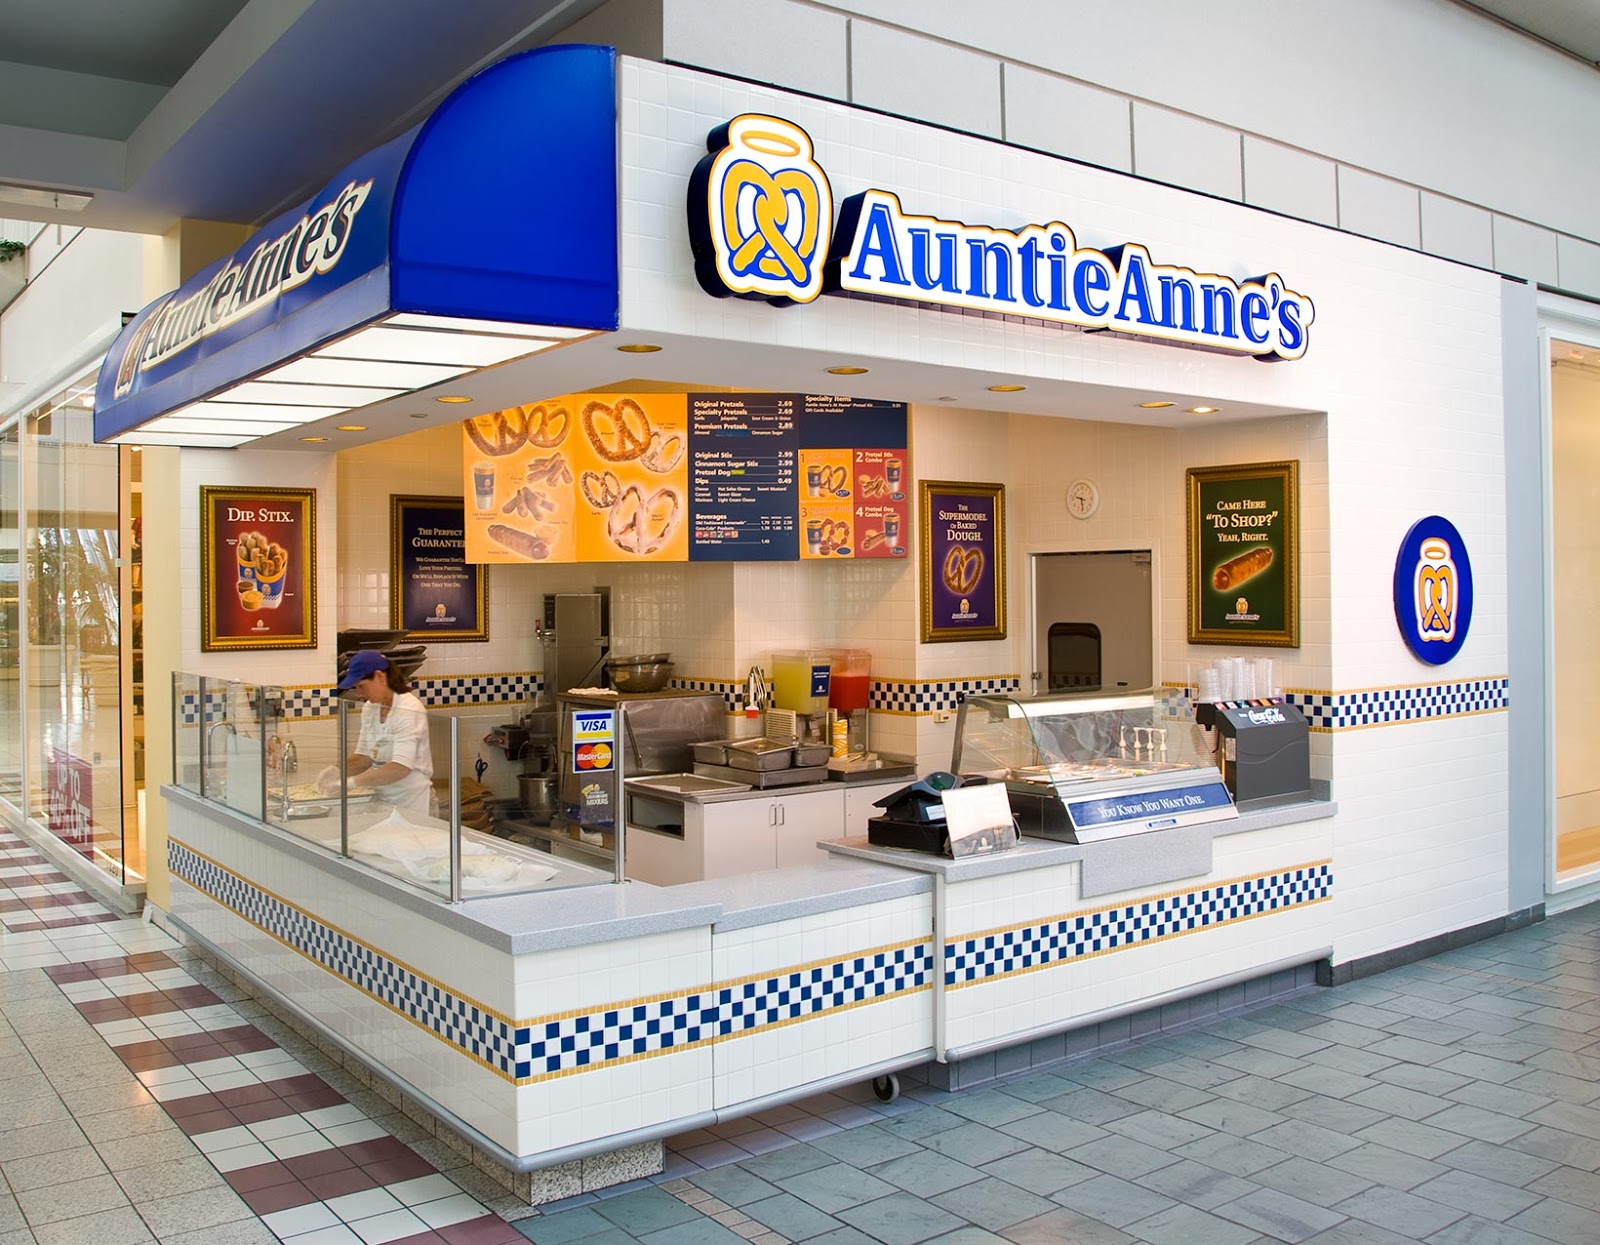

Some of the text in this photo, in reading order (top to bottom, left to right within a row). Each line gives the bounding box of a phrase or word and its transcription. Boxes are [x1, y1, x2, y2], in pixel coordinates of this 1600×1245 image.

[805, 395, 833, 403] Specialty
[694, 401, 719, 409] Original
[856, 452, 863, 463] 2
[727, 460, 745, 468] Sugar
[1217, 500, 1266, 511] CAME HERE
[801, 508, 807, 517] 3
[856, 507, 863, 517] 4
[939, 510, 987, 521] SUPERMODEL
[695, 513, 727, 521] Beverages
[957, 522, 977, 530] BAKED
[434, 528, 463, 536] PERFECT
[581, 720, 607, 732] VISA
[576, 752, 611, 761] MasterCard
[69, 767, 81, 801] TO
[1097, 795, 1205, 819] YOU KNOW YOU WANT ONE.
